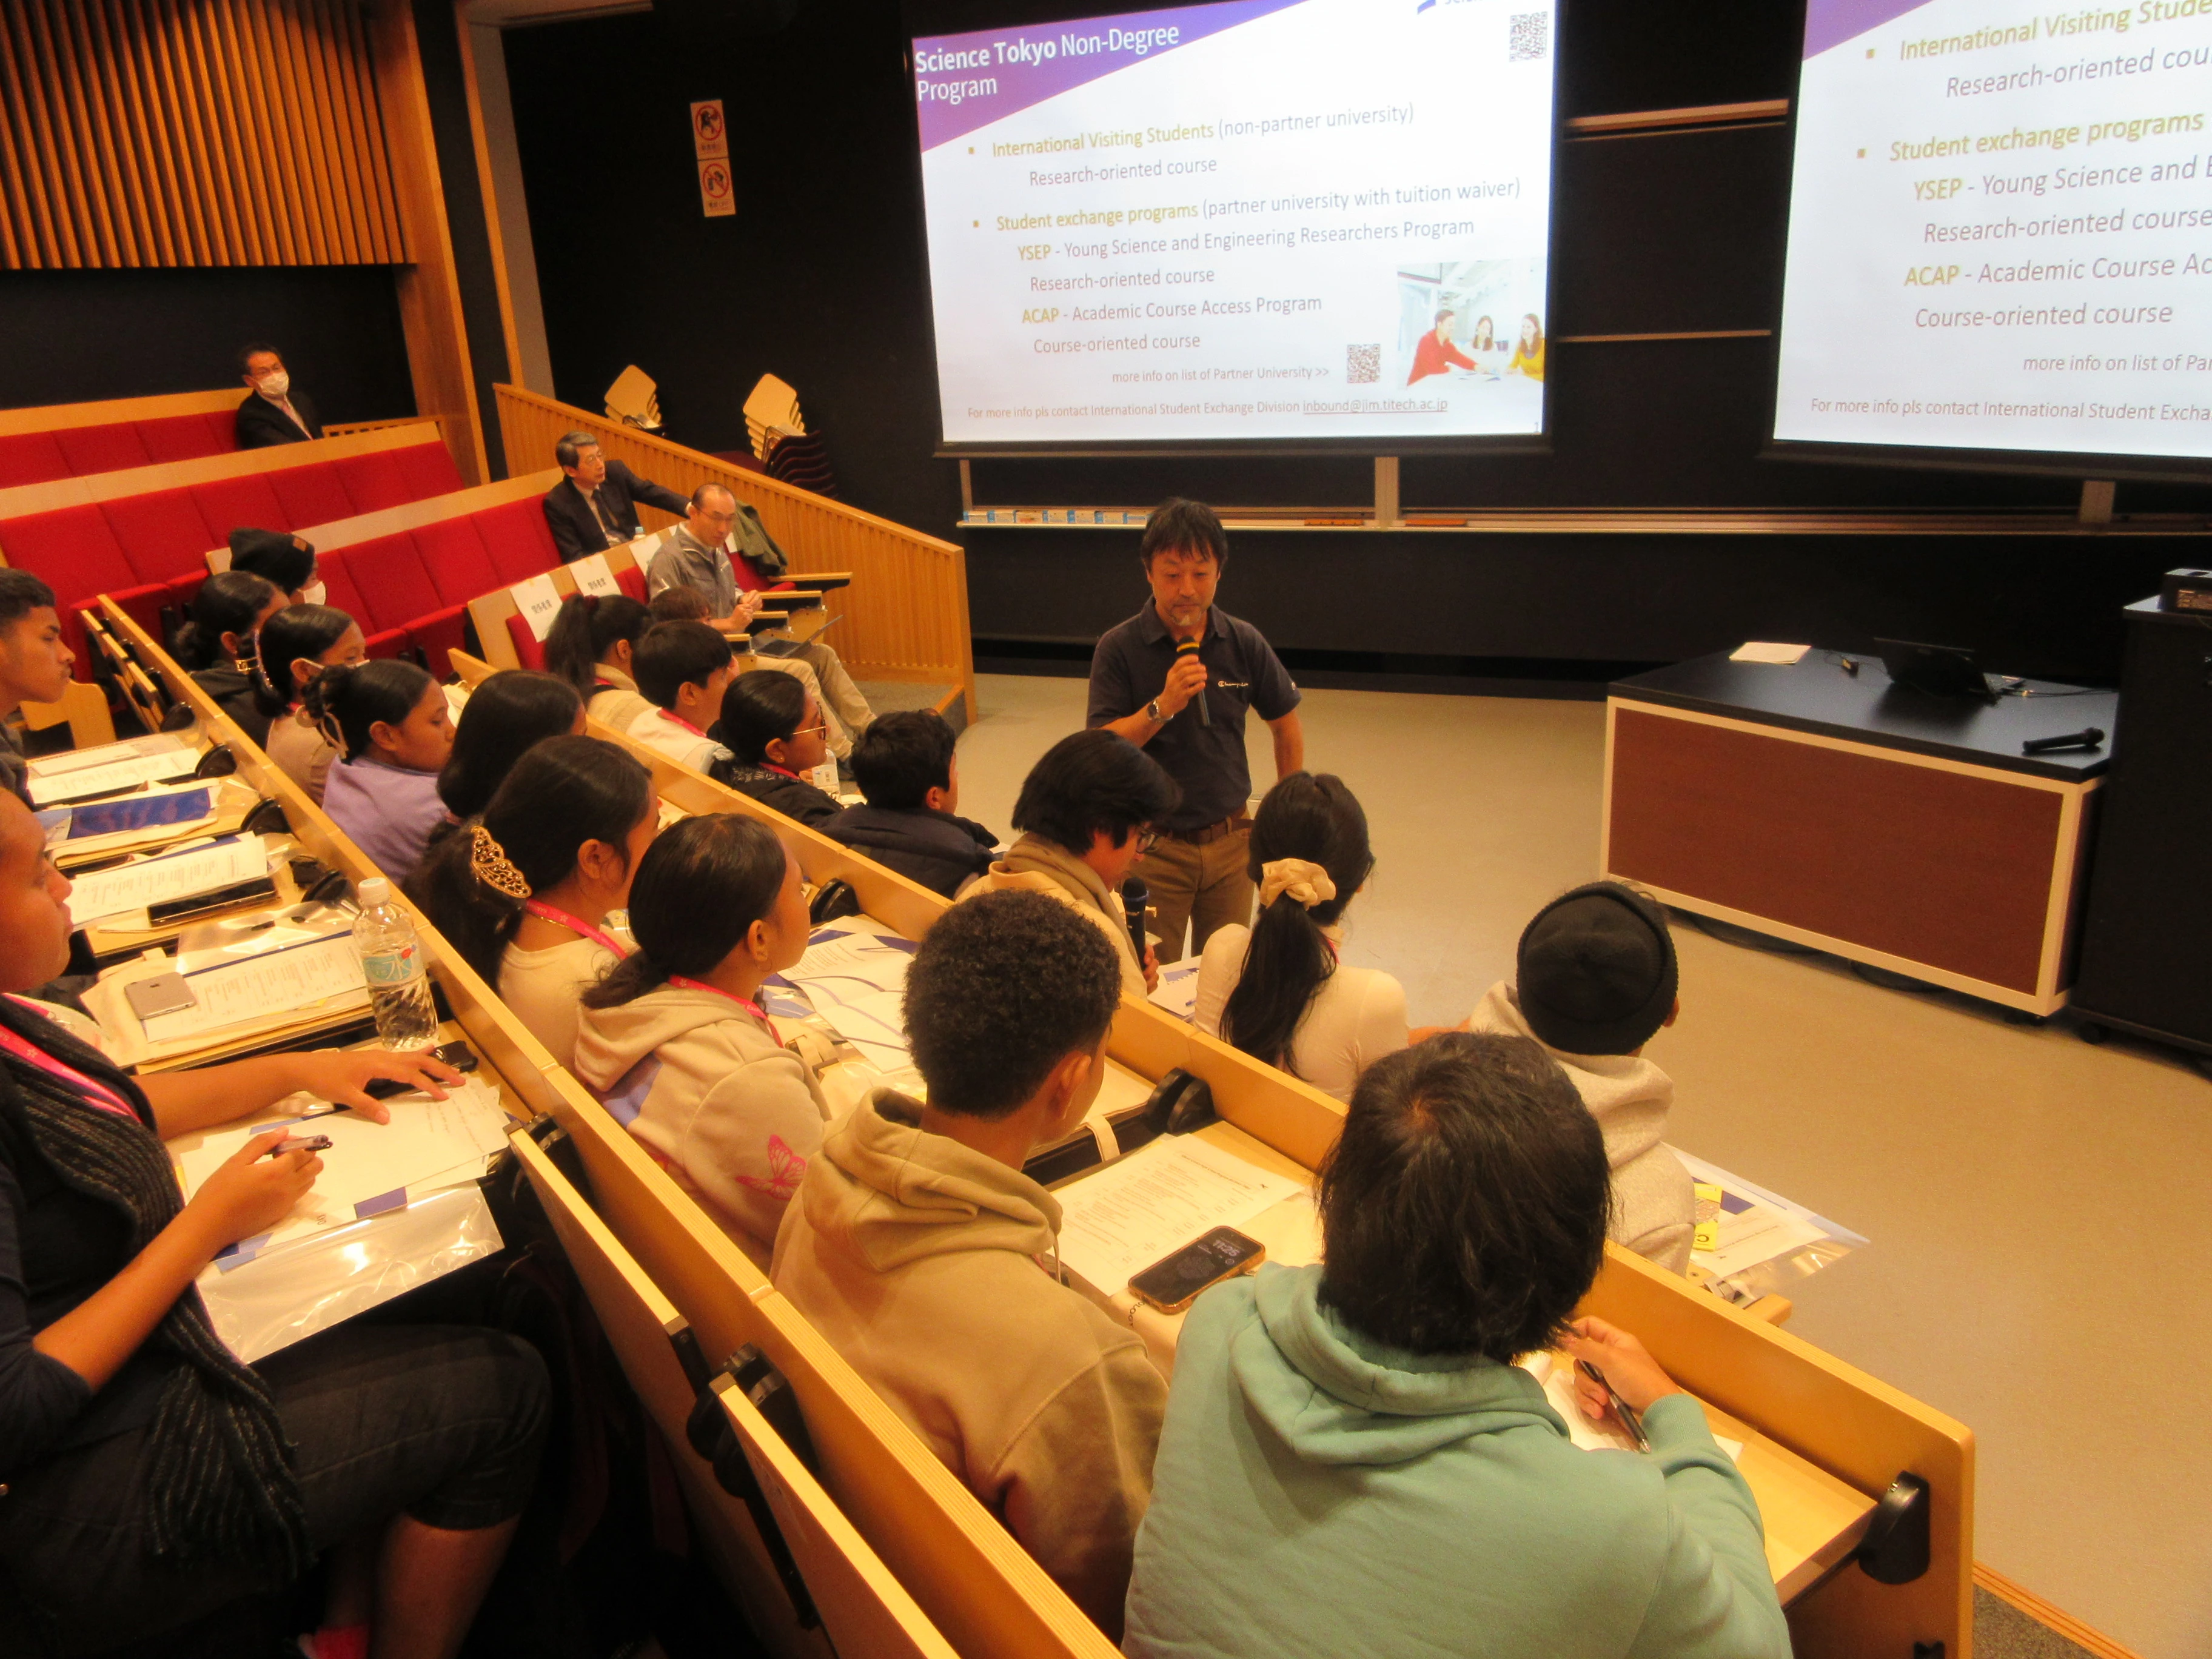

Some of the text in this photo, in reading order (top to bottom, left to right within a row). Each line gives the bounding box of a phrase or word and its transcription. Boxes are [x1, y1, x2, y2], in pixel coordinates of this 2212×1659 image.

[916, 25, 1179, 73] Science Tokyo Non-Degree
[1900, 16, 2038, 61] International
[2045, 8, 2133, 38] Visiting
[1947, 47, 2212, 98] Research-oriented cou
[918, 76, 997, 105] Program
[992, 102, 1414, 158] International Visiting Students (non-partner university)
[1889, 113, 2204, 162] Student exchange programs
[1030, 158, 1218, 186] Research-oriented course
[1914, 179, 1962, 201] YSEP
[1982, 174, 2048, 196] Young
[2054, 166, 2142, 189] Science
[2151, 155, 2197, 181] and
[997, 176, 1521, 231] Student exchange programs (partner university with tuition waiver)
[1017, 244, 1051, 261] YSEP
[1064, 240, 1108, 259] Young
[1112, 238, 1167, 255] Science
[1171, 233, 1199, 250] and
[1204, 230, 1295, 251] Engineering
[1301, 224, 1398, 243] Researchers
[1404, 221, 1474, 240] Program
[1925, 208, 2212, 244] Research-oriented course
[1030, 269, 1214, 292] Research-oriented course
[1905, 265, 1960, 286] ACAP
[1977, 259, 2085, 283] Academic
[2093, 258, 2174, 278] Course
[2183, 253, 2212, 275] Ac
[1022, 308, 1059, 324] ACAP
[1072, 304, 1142, 321] Academic
[1146, 302, 1196, 318] Course
[1202, 299, 1251, 315] Access
[1256, 297, 1322, 315] Program
[1915, 302, 2173, 327] Course-oriented course
[1034, 334, 1201, 354] Course-oriented course
[1112, 371, 1139, 383] more
[1143, 369, 1163, 382] info
[1165, 372, 1178, 381] on
[1182, 369, 1197, 381] list
[1200, 368, 1211, 381] of
[1214, 367, 1253, 380] Partner
[1257, 366, 1312, 381] University
[2023, 354, 2212, 371] more info on list of Par
[968, 397, 1448, 420] For more info pls contact International Student Exchange Division inbound@jim.titech.ac.jp
[1812, 398, 2212, 421] For more info pls contact International Student Excha
